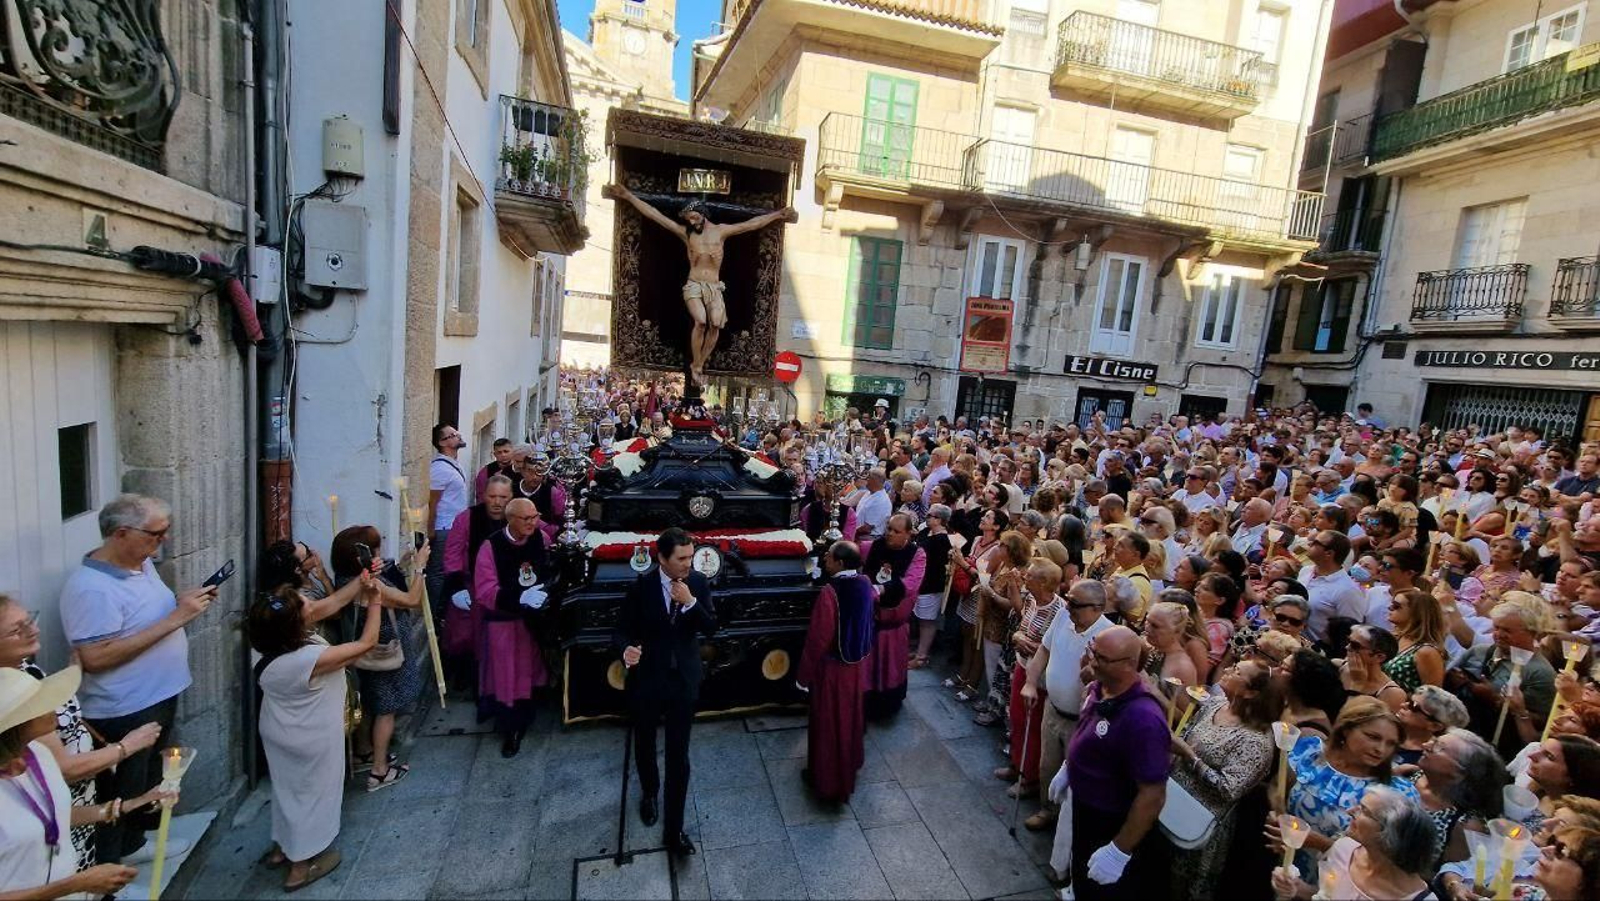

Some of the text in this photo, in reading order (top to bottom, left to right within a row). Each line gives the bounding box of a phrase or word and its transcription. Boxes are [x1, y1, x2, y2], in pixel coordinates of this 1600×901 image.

[1070, 356, 1154, 380] El Cisne
[1425, 352, 1486, 366] JULIO
[1494, 352, 1553, 367] RICO
